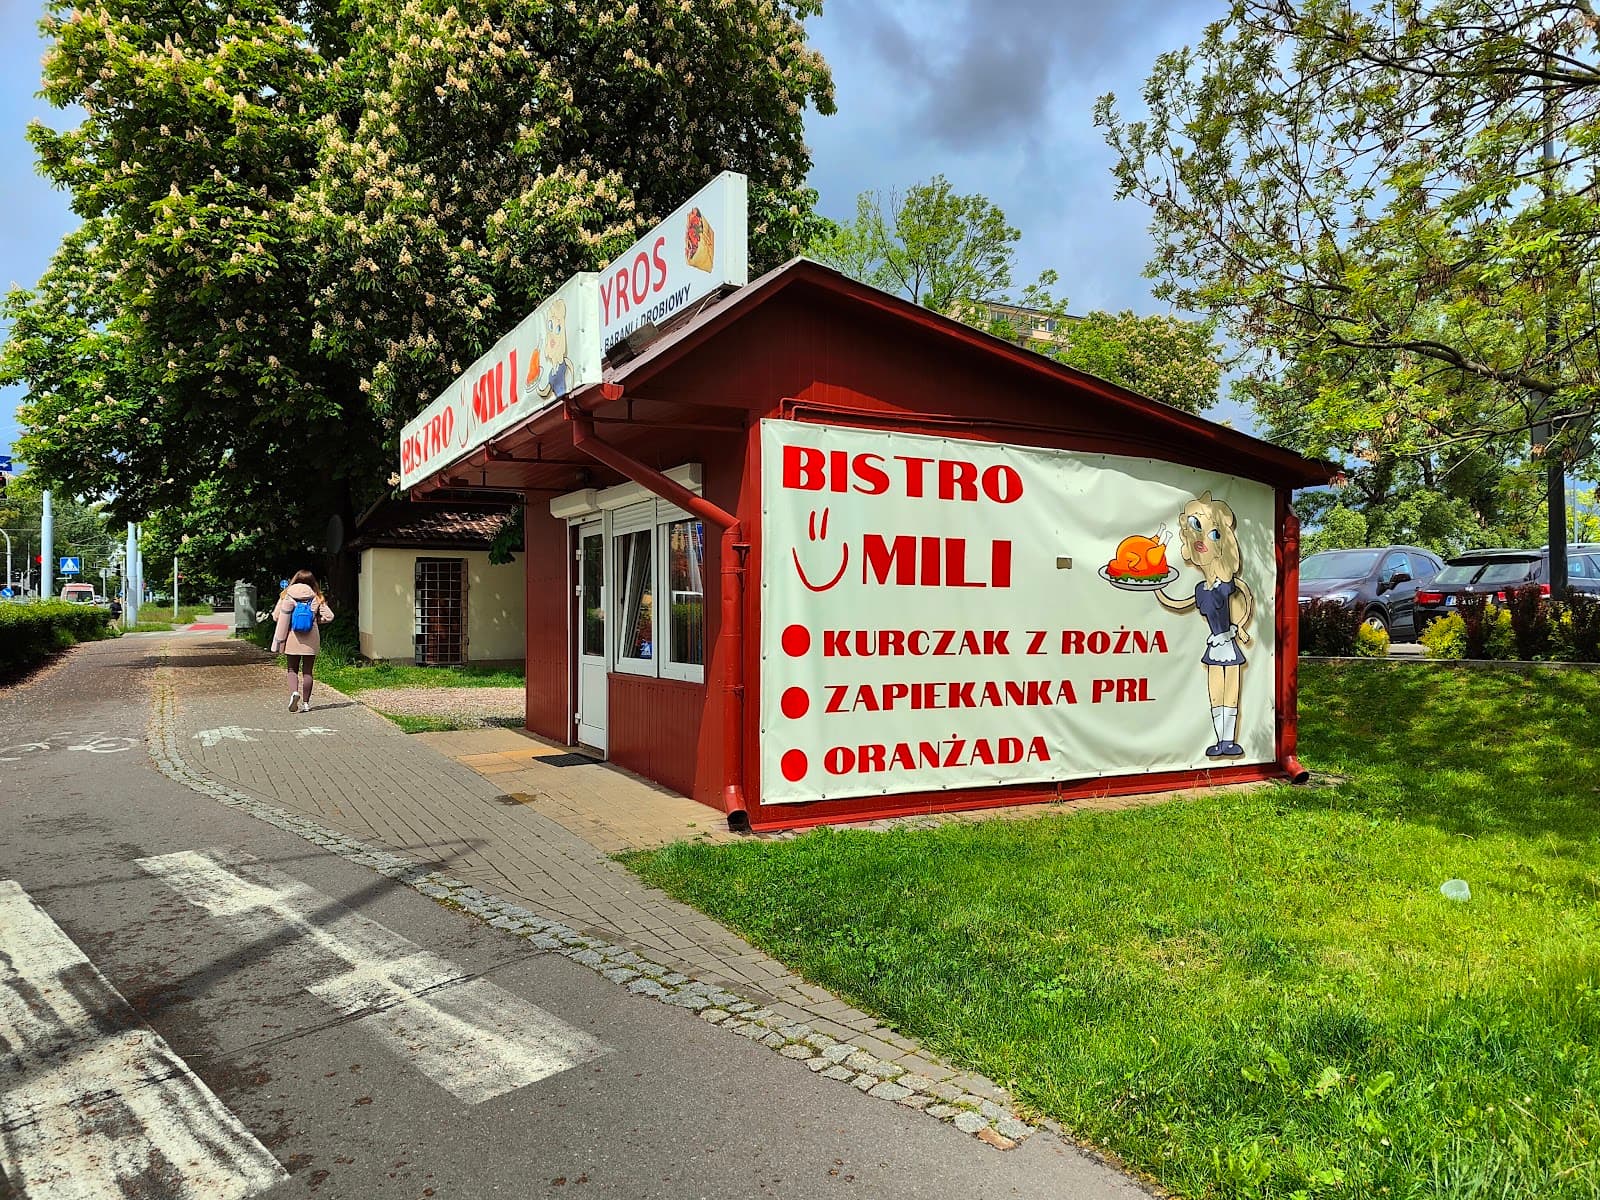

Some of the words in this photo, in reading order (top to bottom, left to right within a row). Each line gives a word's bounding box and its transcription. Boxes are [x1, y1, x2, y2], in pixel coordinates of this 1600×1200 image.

[640, 283, 691, 327] DROBIOWY
[402, 405, 454, 475] BISTRO
[472, 348, 518, 430] MILI
[782, 444, 1024, 504] BISTRO
[862, 533, 1012, 588] MILI
[823, 629, 1010, 657] KURCZAK
[1026, 630, 1047, 655] Z
[1061, 624, 1169, 655] ROŻNA
[823, 678, 1078, 714] ZAPIEKANKA
[1091, 677, 1156, 704] PRL
[823, 733, 1051, 776] ORANŻADA
